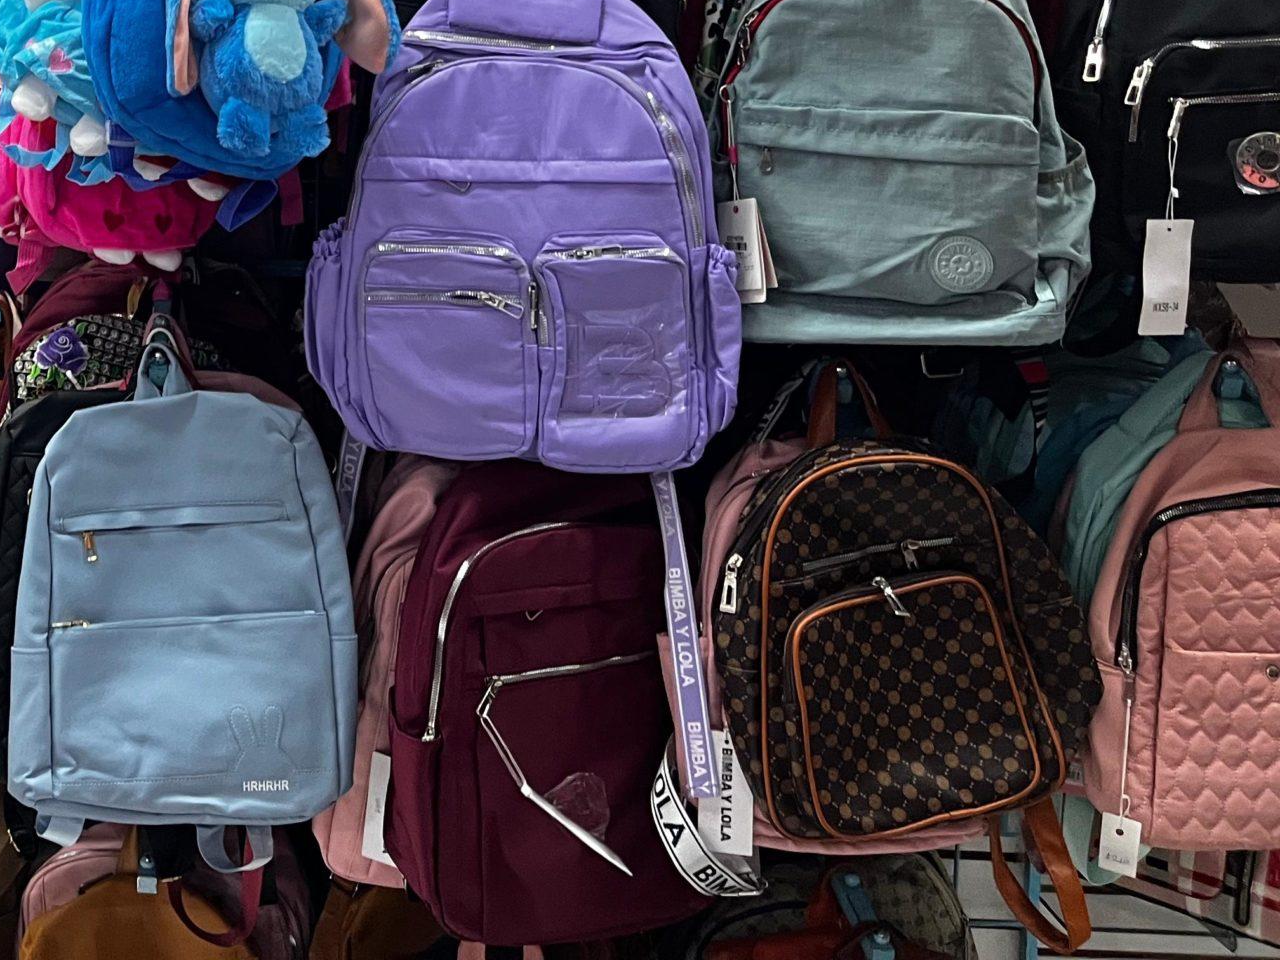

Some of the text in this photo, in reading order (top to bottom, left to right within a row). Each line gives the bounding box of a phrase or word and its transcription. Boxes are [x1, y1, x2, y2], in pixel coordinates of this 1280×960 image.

[668, 567, 696, 687] BIMBA Y LOLA
[242, 779, 290, 792] HRHRHR
[687, 721, 711, 795] BIMBA Y
[720, 747, 734, 842] BIMBA Y LOLA
